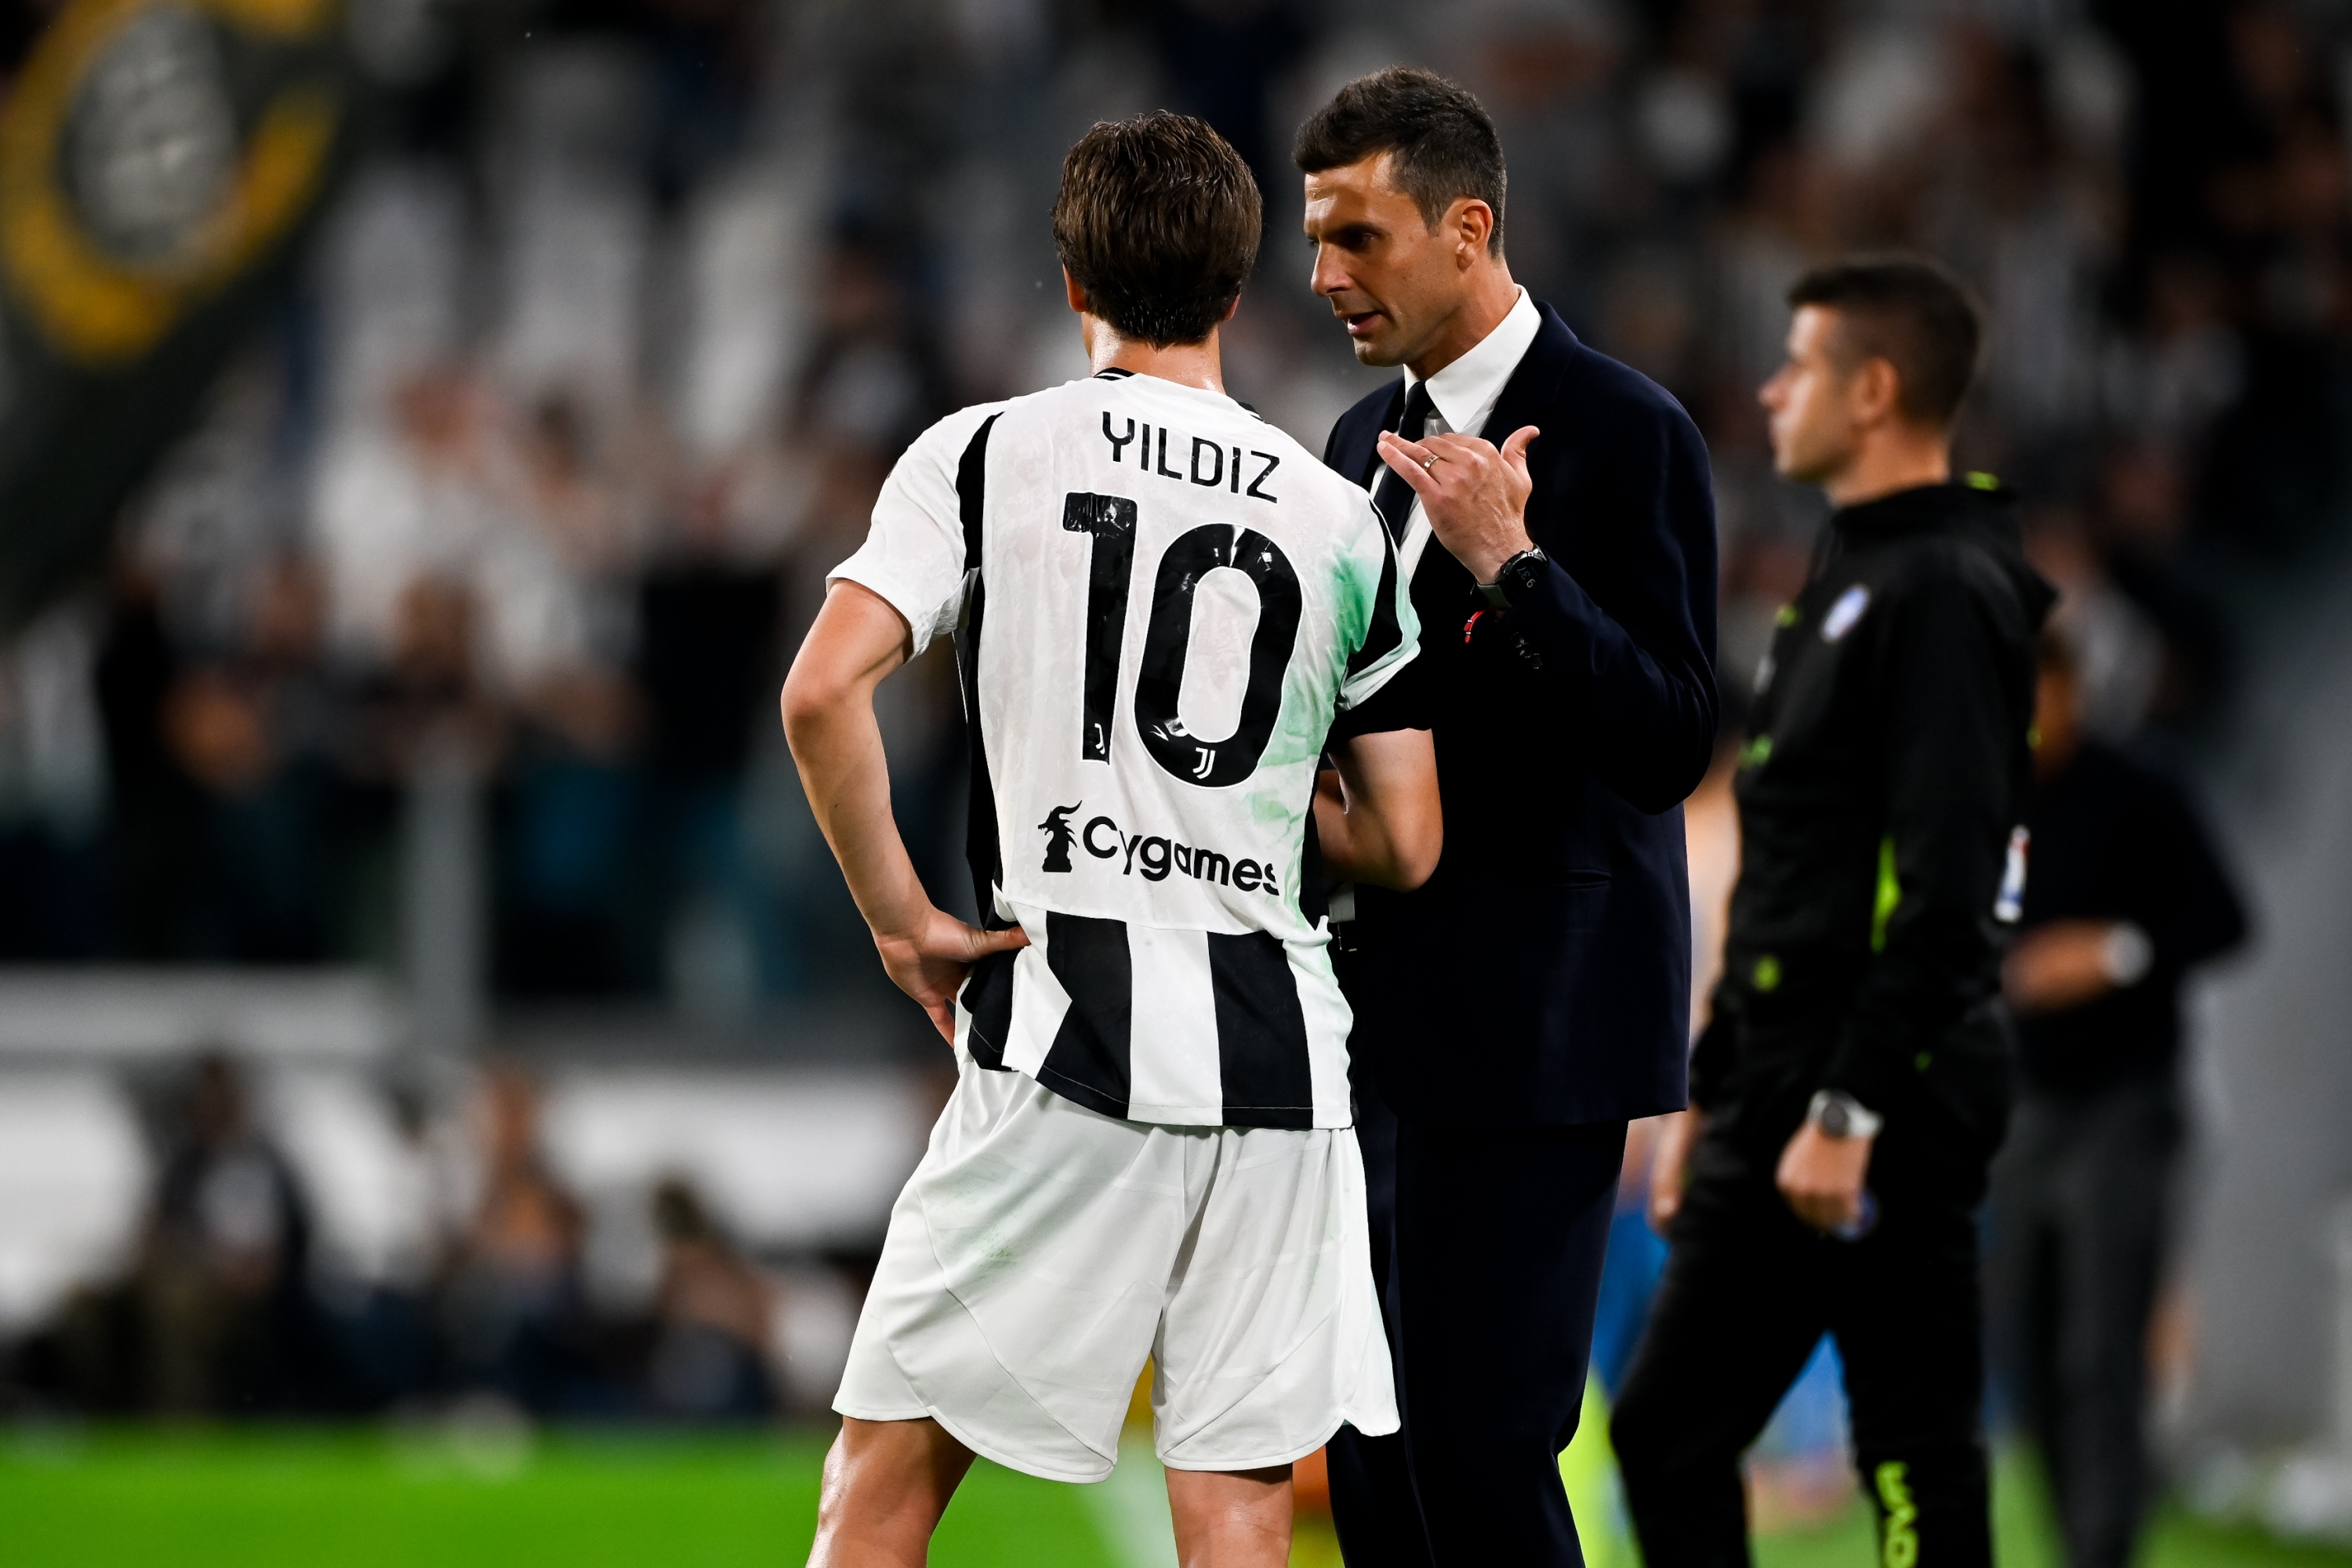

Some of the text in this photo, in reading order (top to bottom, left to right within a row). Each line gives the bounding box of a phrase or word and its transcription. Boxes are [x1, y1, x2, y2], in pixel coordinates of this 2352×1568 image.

[1102, 412, 1280, 504] YILDIZ
[1062, 492, 1303, 788] 10
[1082, 815, 1279, 896] Cygames
